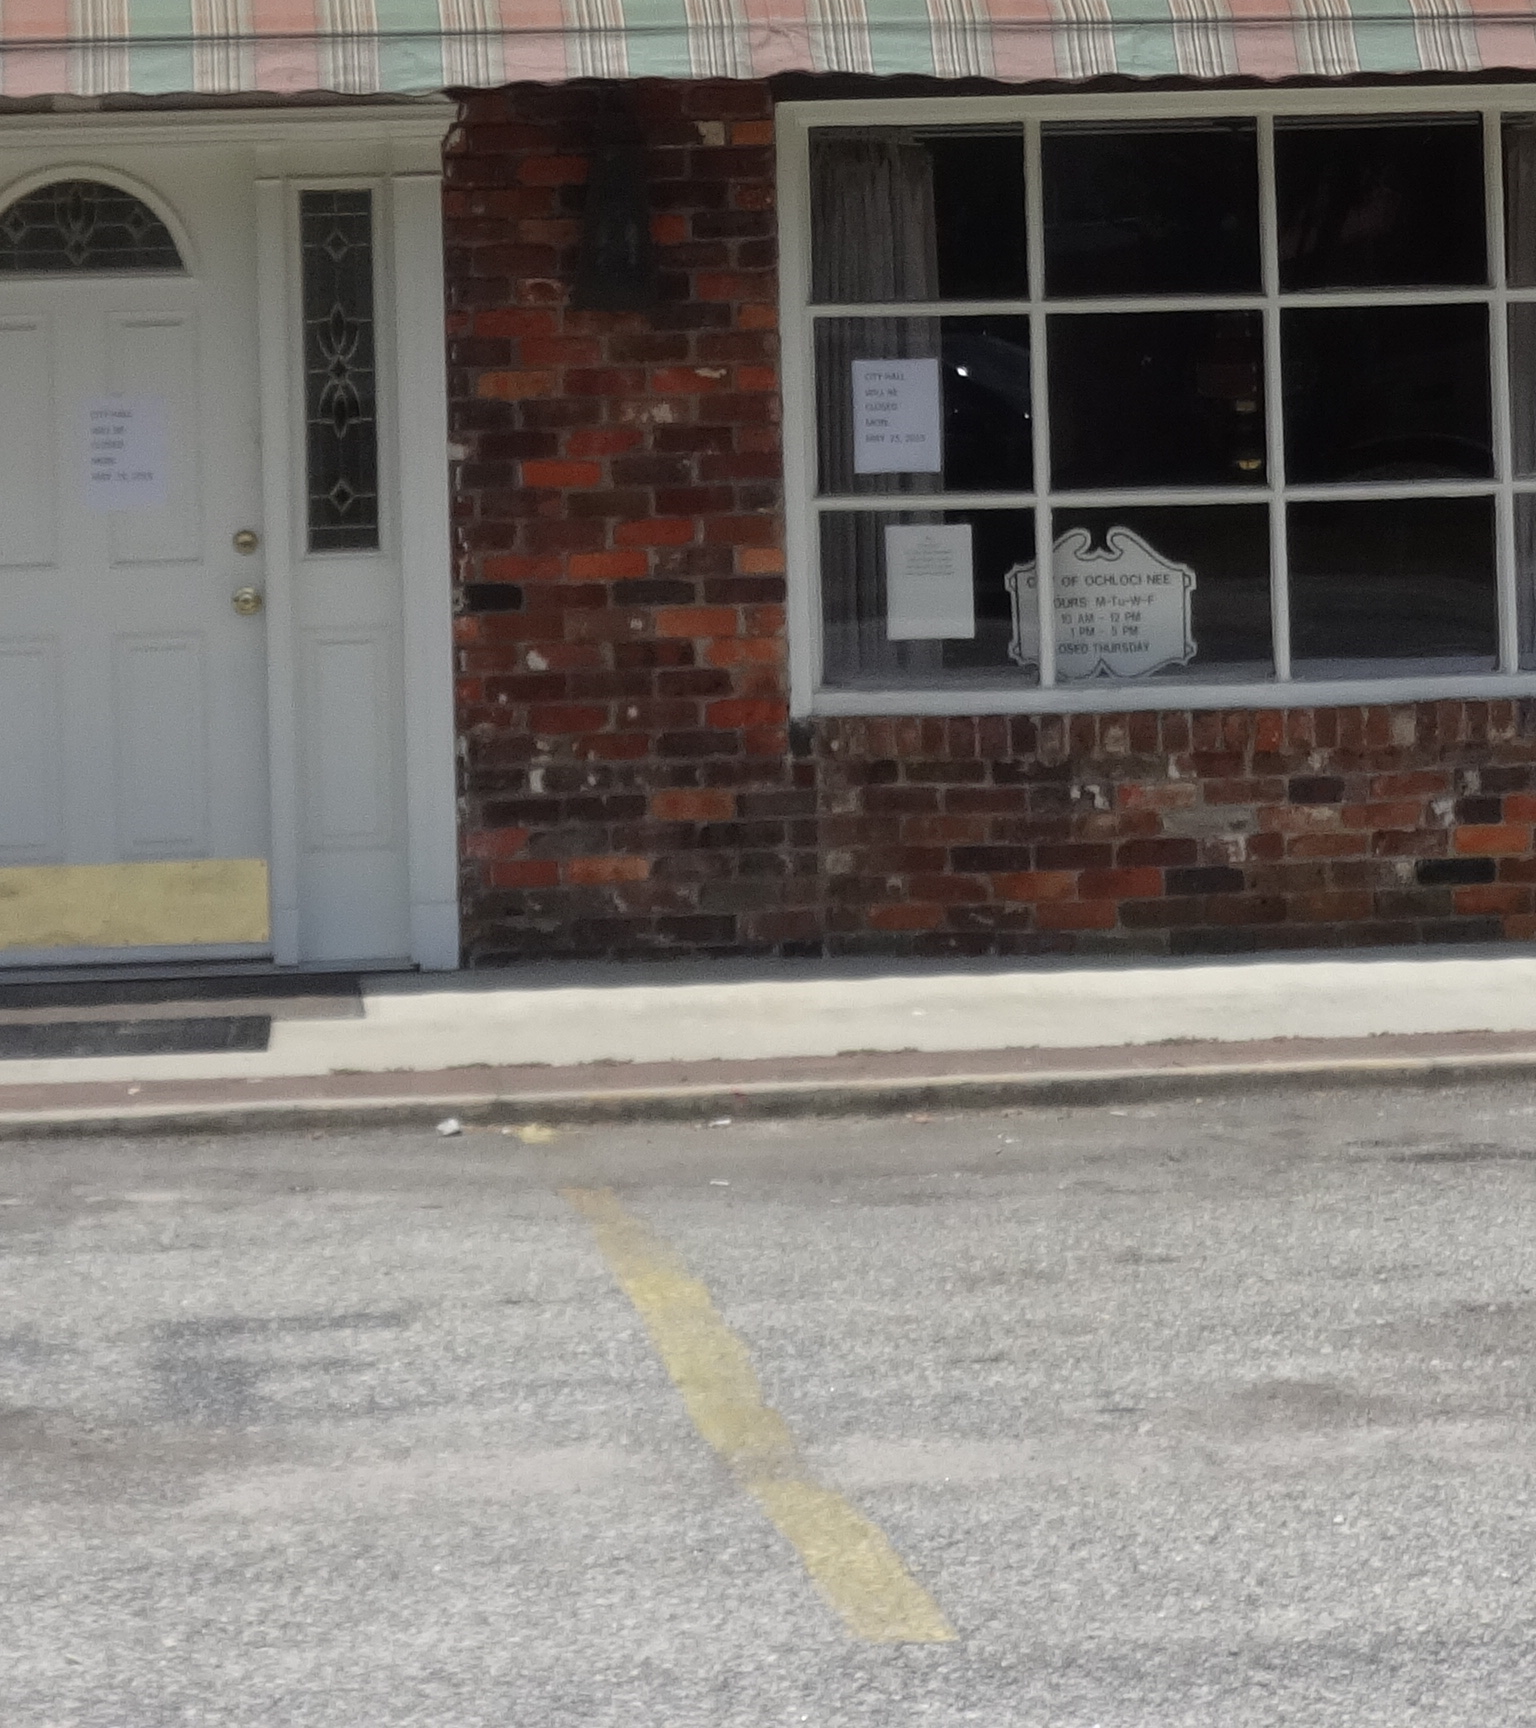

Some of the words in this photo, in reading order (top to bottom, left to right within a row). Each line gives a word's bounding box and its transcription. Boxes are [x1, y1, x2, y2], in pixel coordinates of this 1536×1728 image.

[1060, 575, 1079, 588] OF
[1053, 596, 1088, 610] OURS
[1078, 612, 1095, 624] AM
[1124, 611, 1142, 623] PM
[1079, 626, 1095, 637] PM
[1122, 625, 1139, 637] PM
[1092, 642, 1151, 654] THURSDAY
